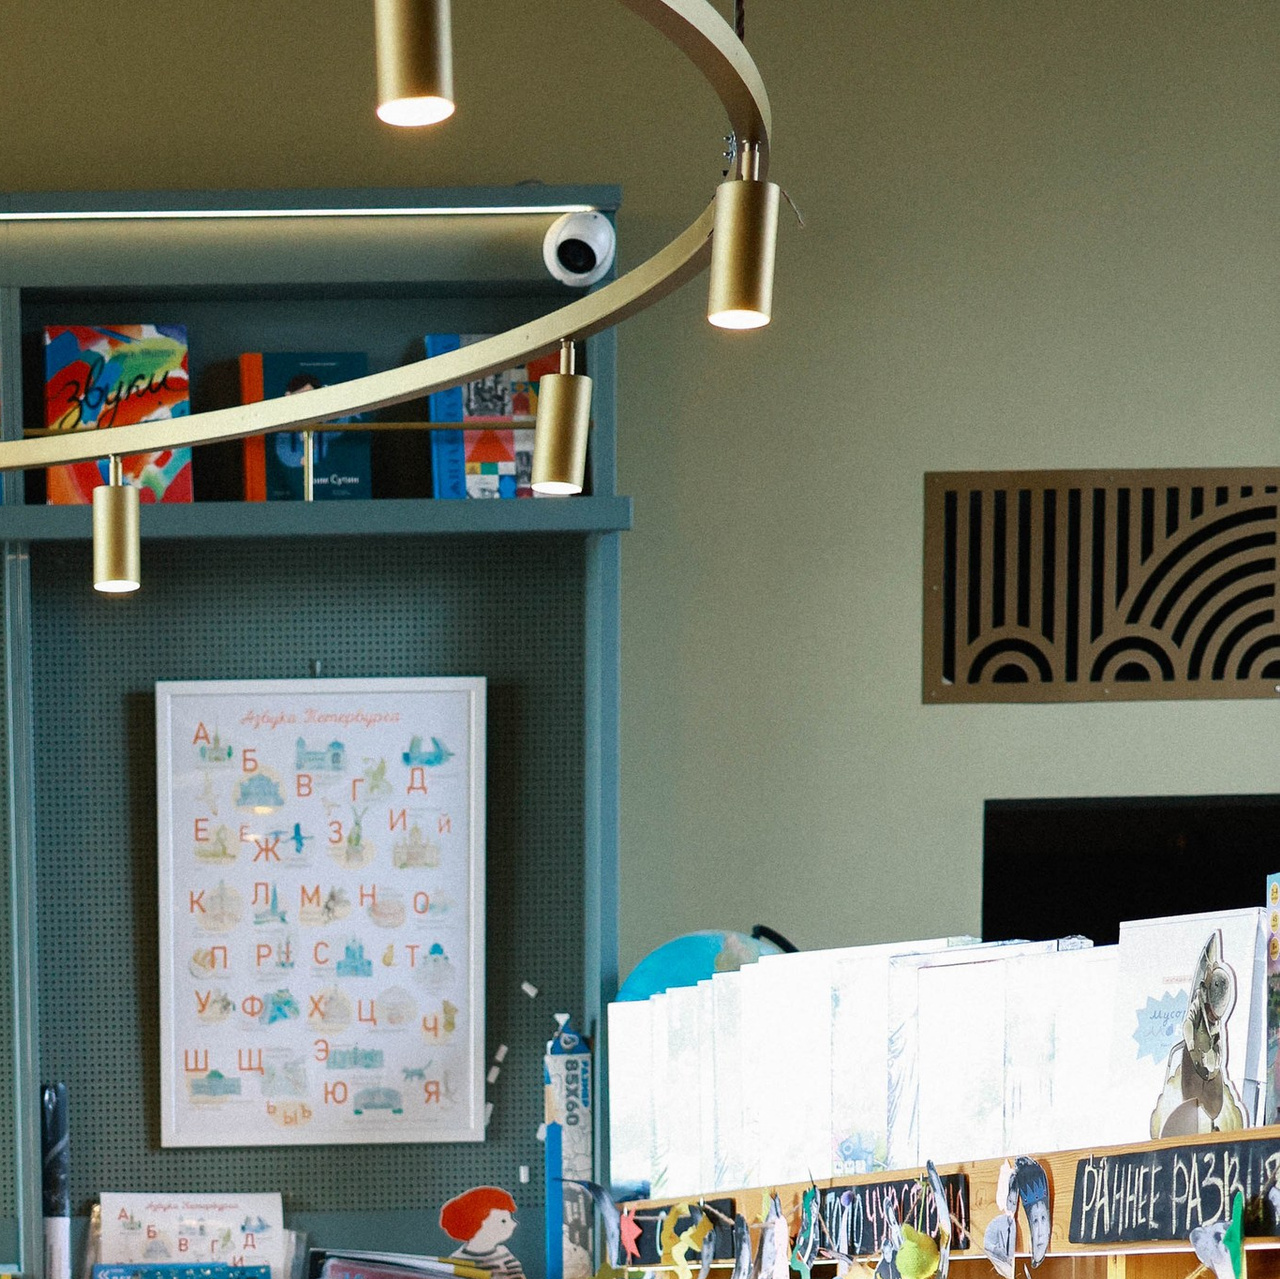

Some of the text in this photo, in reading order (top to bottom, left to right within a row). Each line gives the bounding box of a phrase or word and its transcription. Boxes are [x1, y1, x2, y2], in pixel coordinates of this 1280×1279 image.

[192, 721, 211, 745] А
[242, 748, 258, 772] Б
[296, 773, 313, 797] В
[351, 778, 365, 801] Г
[406, 767, 428, 794] Д
[194, 818, 209, 842] Е
[388, 808, 407, 831] И
[328, 820, 343, 844] З
[253, 837, 281, 862] Ж
[189, 890, 206, 913] К
[251, 882, 269, 905] Л
[300, 884, 321, 907] М
[359, 884, 376, 907] Н
[413, 891, 430, 914] О
[210, 945, 227, 969] П
[256, 944, 272, 966] Р
[313, 940, 329, 964] С
[405, 945, 420, 967] Т
[195, 989, 211, 1014] У
[241, 995, 264, 1017] Ф
[309, 994, 325, 1019] Х
[358, 1000, 377, 1026] Ц
[422, 1014, 439, 1038] Ч
[184, 1049, 209, 1072] Ш
[237, 1049, 265, 1076] Щ
[313, 1039, 329, 1062] Э
[323, 1080, 348, 1104] Ю
[424, 1080, 440, 1104] Я
[1081, 1150, 1280, 1240] РАННЕЕ РАЗВИ
[118, 1208, 129, 1220] А
[147, 1225, 158, 1239] Б
[243, 1233, 257, 1250] Д
[178, 1238, 189, 1252] В
